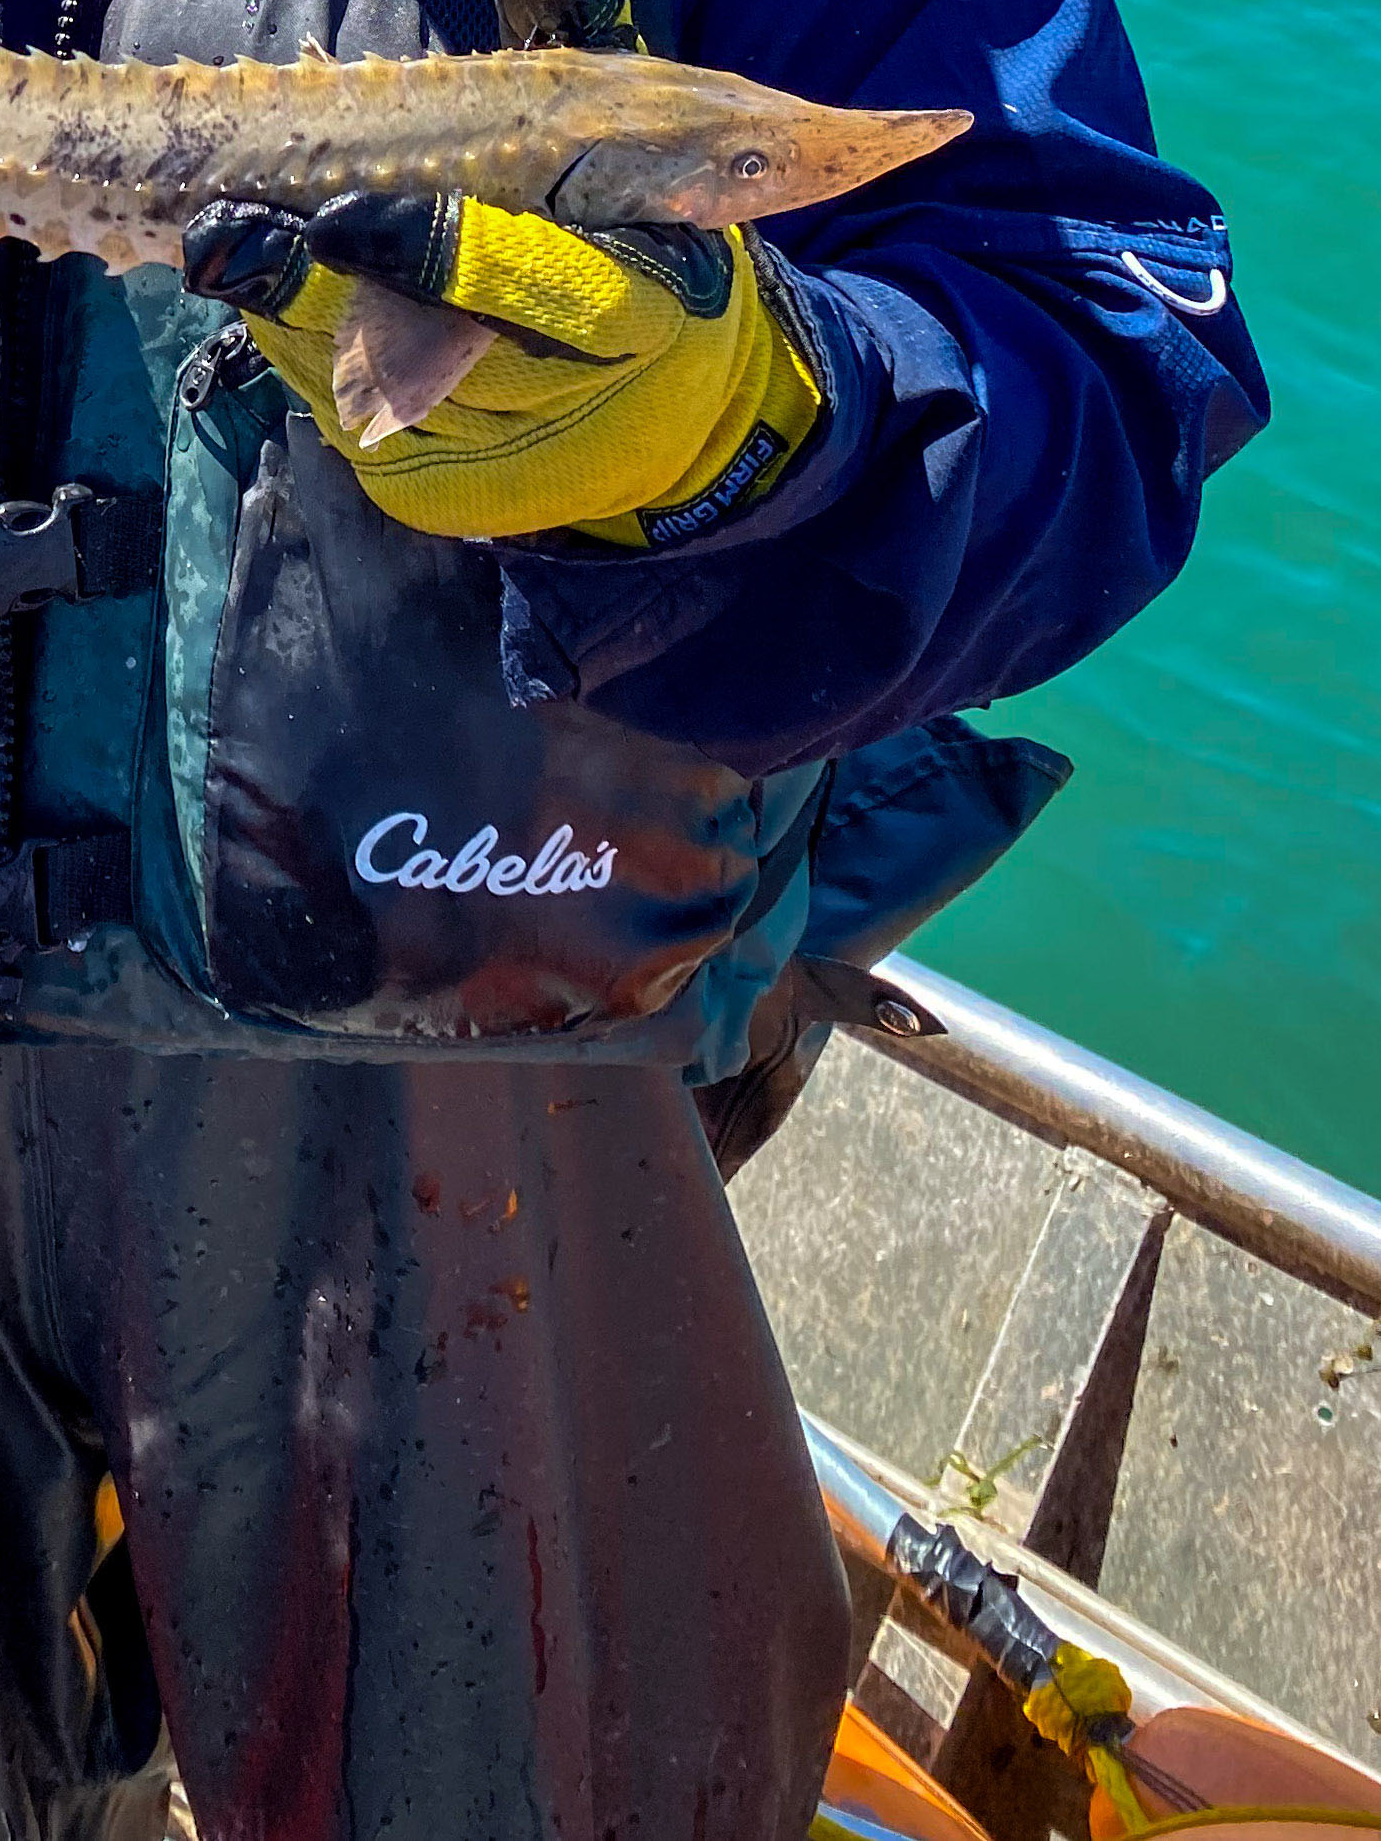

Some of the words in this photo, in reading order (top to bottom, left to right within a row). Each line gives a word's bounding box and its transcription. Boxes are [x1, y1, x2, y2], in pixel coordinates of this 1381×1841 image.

[713, 438, 773, 507] FIRM
[651, 500, 720, 542] GRIP
[354, 811, 619, 896] Cabela's
